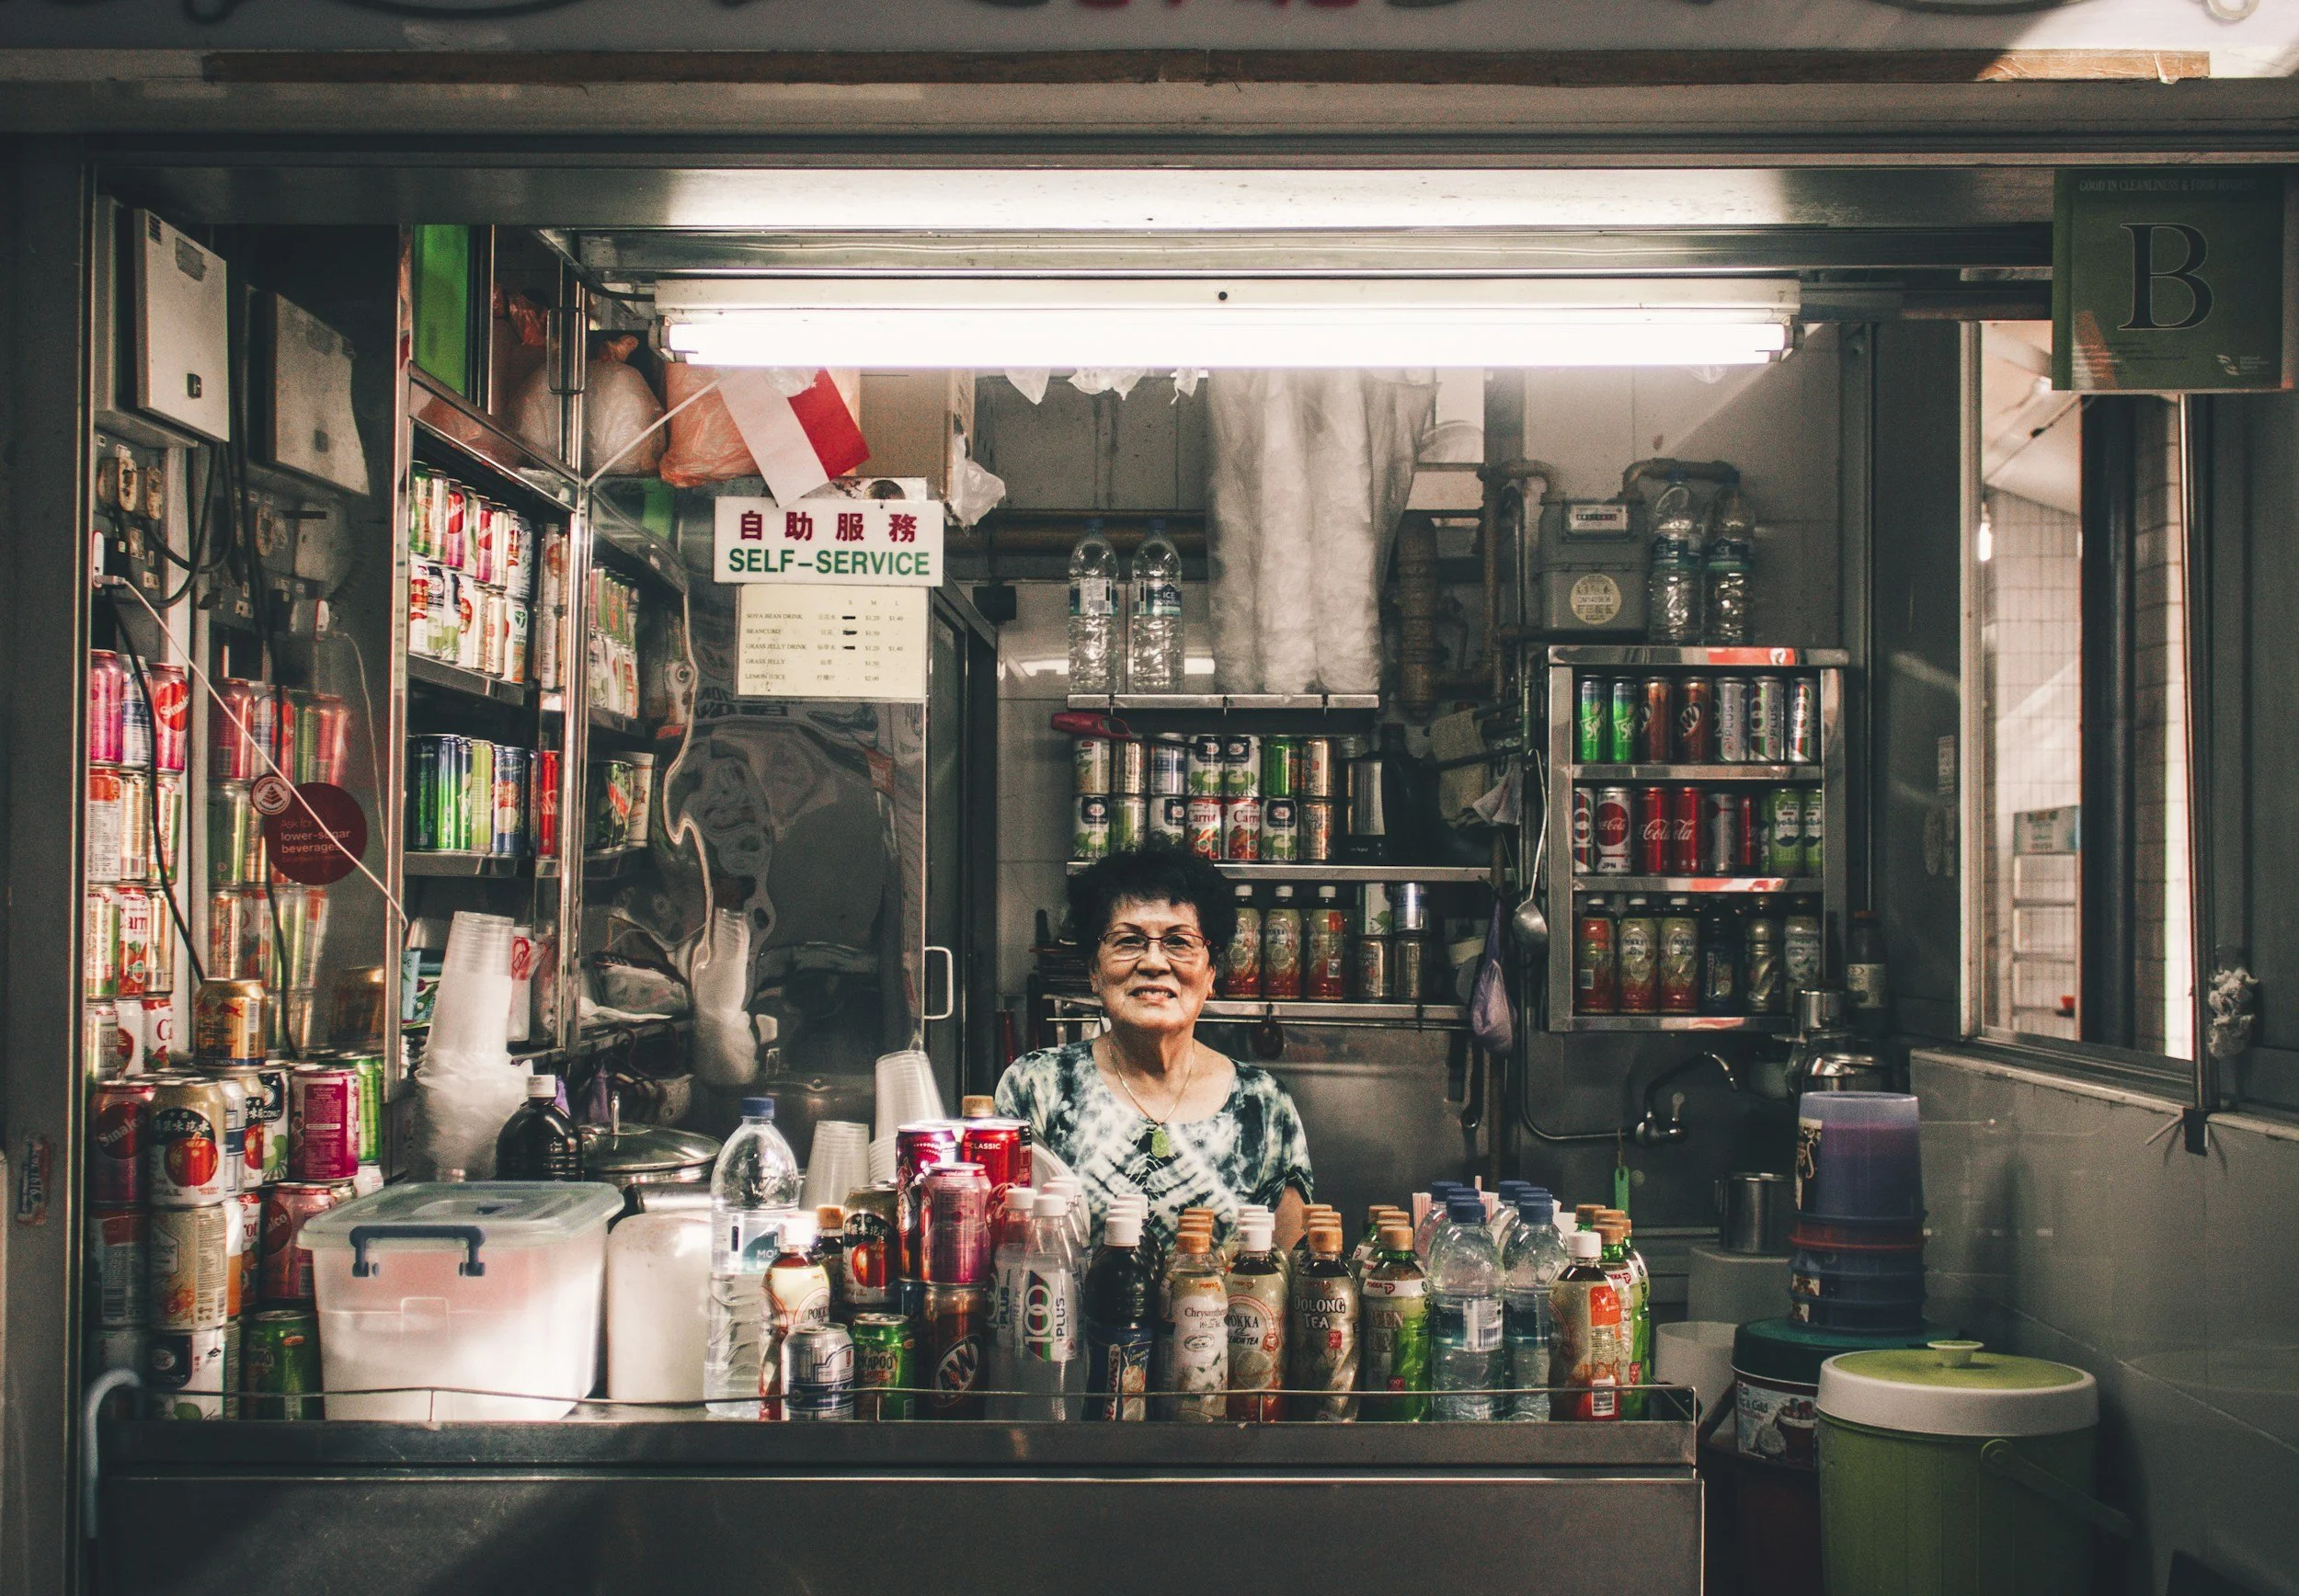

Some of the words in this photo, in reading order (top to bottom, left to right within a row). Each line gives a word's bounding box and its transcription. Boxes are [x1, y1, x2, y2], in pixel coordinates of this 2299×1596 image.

[2119, 222, 2214, 331] B
[740, 510, 918, 543] 自助服務
[728, 548, 931, 576] SELF-SERVICE
[1162, 591, 1174, 599] ICE
[1233, 810, 1260, 823] Carr
[281, 843, 341, 854] beverages
[969, 1142, 1001, 1150] CLASSIC
[1293, 1294, 1346, 1314] OOLONG
[808, 1305, 828, 1320] POKK
[1024, 1284, 1055, 1346] 100
[1055, 1297, 1066, 1338] PLUS
[1184, 1306, 1227, 1321] Chrysanthe
[1303, 1313, 1331, 1329] TEA
[1247, 1337, 1259, 1345] TEA
